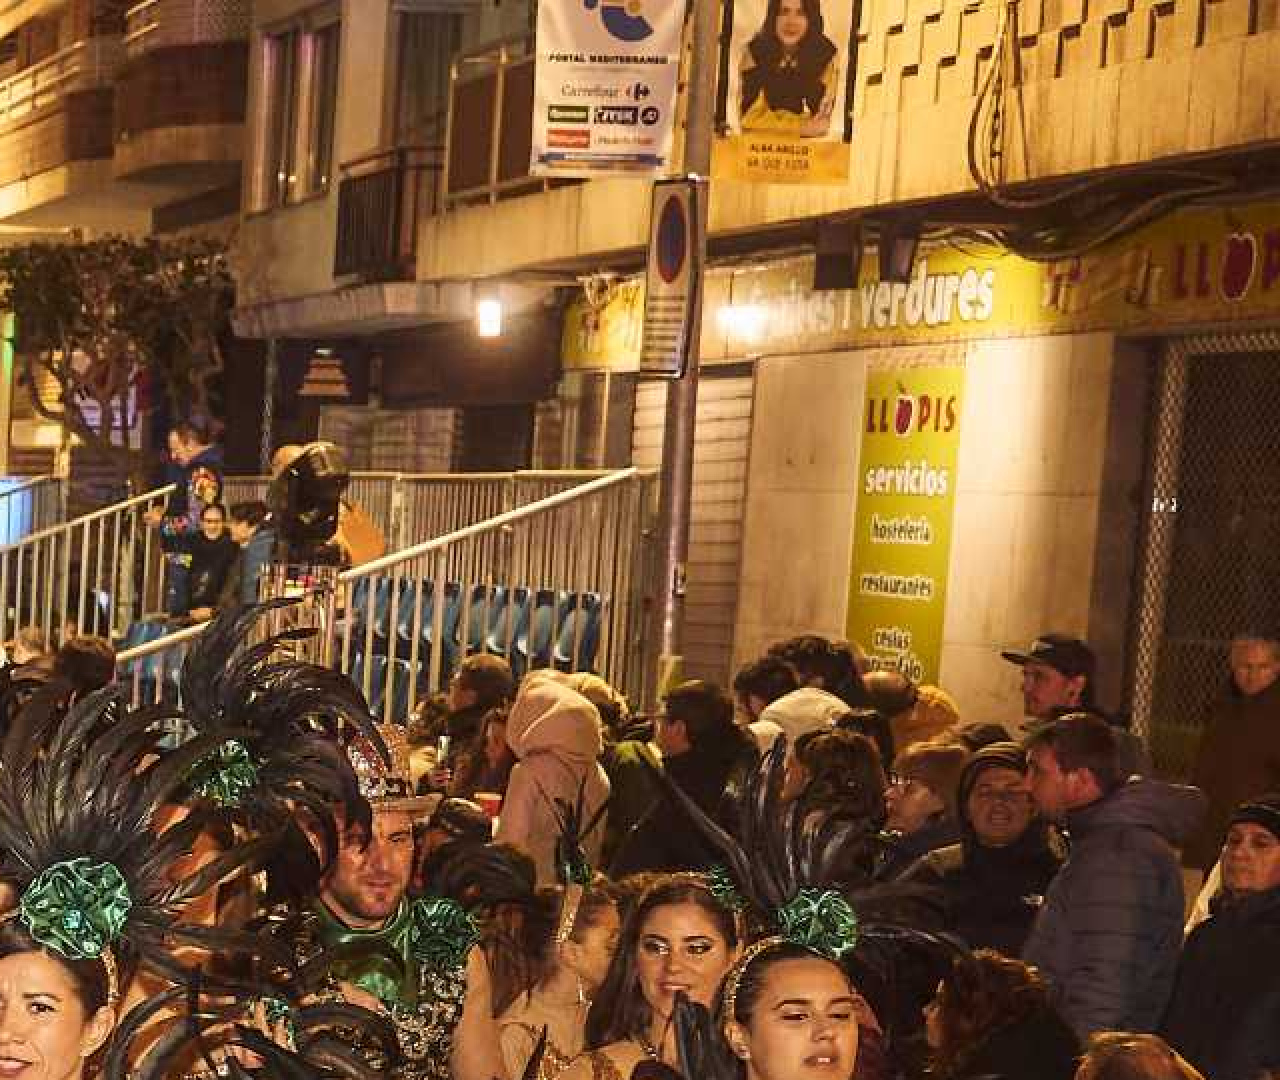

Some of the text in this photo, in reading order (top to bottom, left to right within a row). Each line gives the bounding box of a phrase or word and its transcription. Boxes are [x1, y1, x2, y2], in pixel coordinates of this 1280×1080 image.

[860, 256, 994, 330] verdures
[865, 393, 957, 436] LLOPIS
[864, 458, 949, 498] servicios
[860, 575, 932, 597] restaurantes
